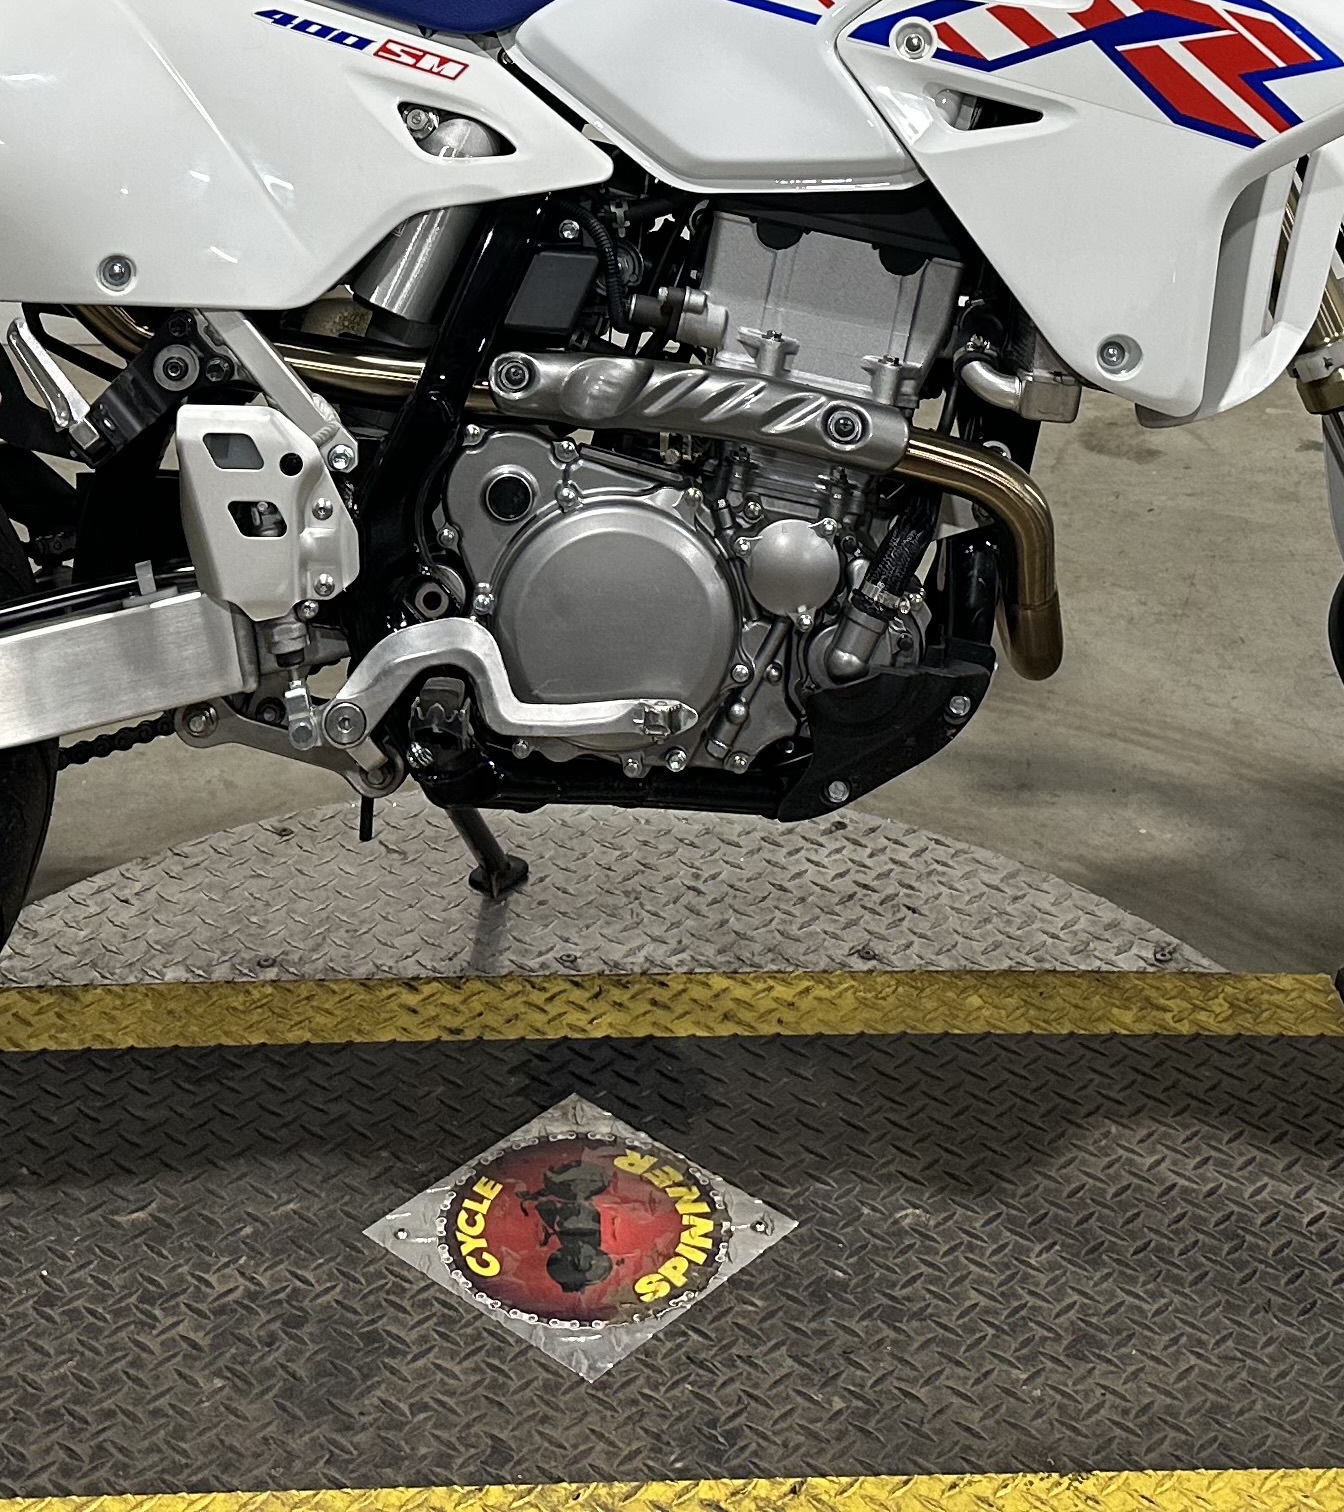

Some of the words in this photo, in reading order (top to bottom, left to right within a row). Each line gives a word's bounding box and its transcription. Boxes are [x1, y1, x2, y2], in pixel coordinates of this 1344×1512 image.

[252, 8, 377, 51] 400
[374, 39, 469, 80] SM
[455, 1175, 504, 1277] CYCLE
[612, 1148, 716, 1303] SPINNER
